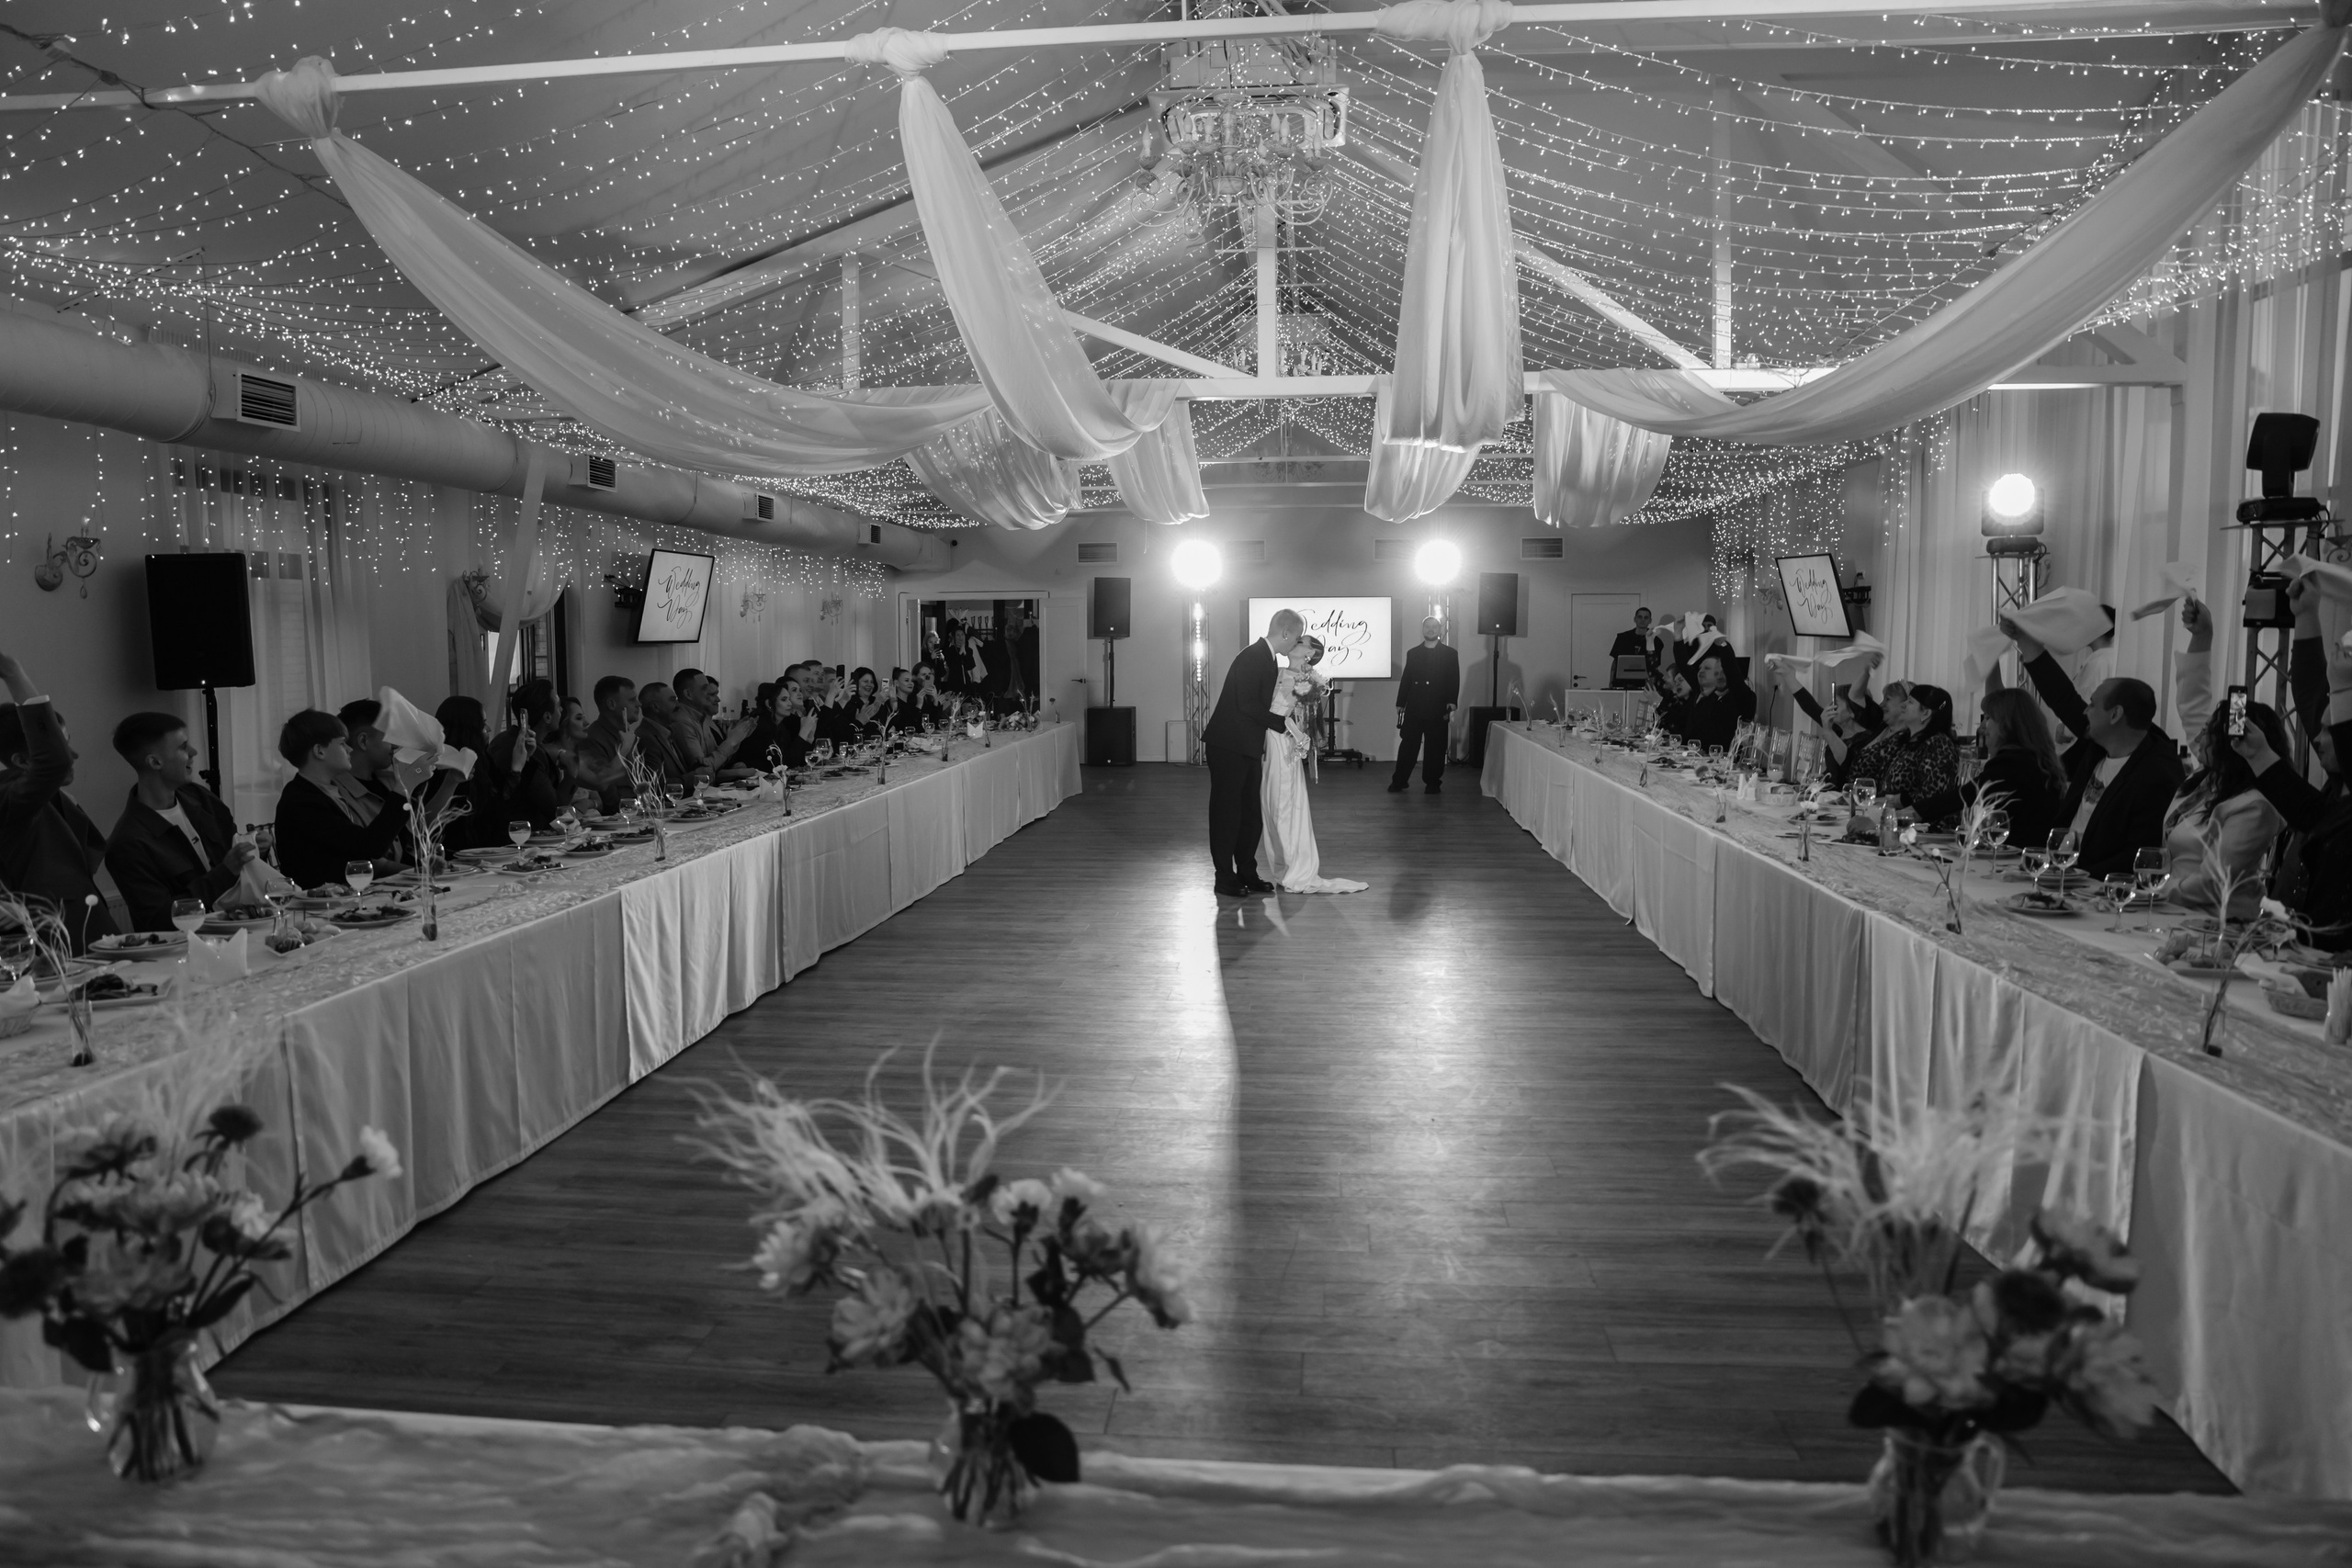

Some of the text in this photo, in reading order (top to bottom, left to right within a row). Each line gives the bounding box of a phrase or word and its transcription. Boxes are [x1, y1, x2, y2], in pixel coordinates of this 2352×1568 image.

[658, 566, 700, 607] Wedding
[1789, 569, 1832, 604] Wedding
[657, 594, 693, 629] Day
[1796, 593, 1834, 624] Day
[1316, 635, 1363, 666] ay
